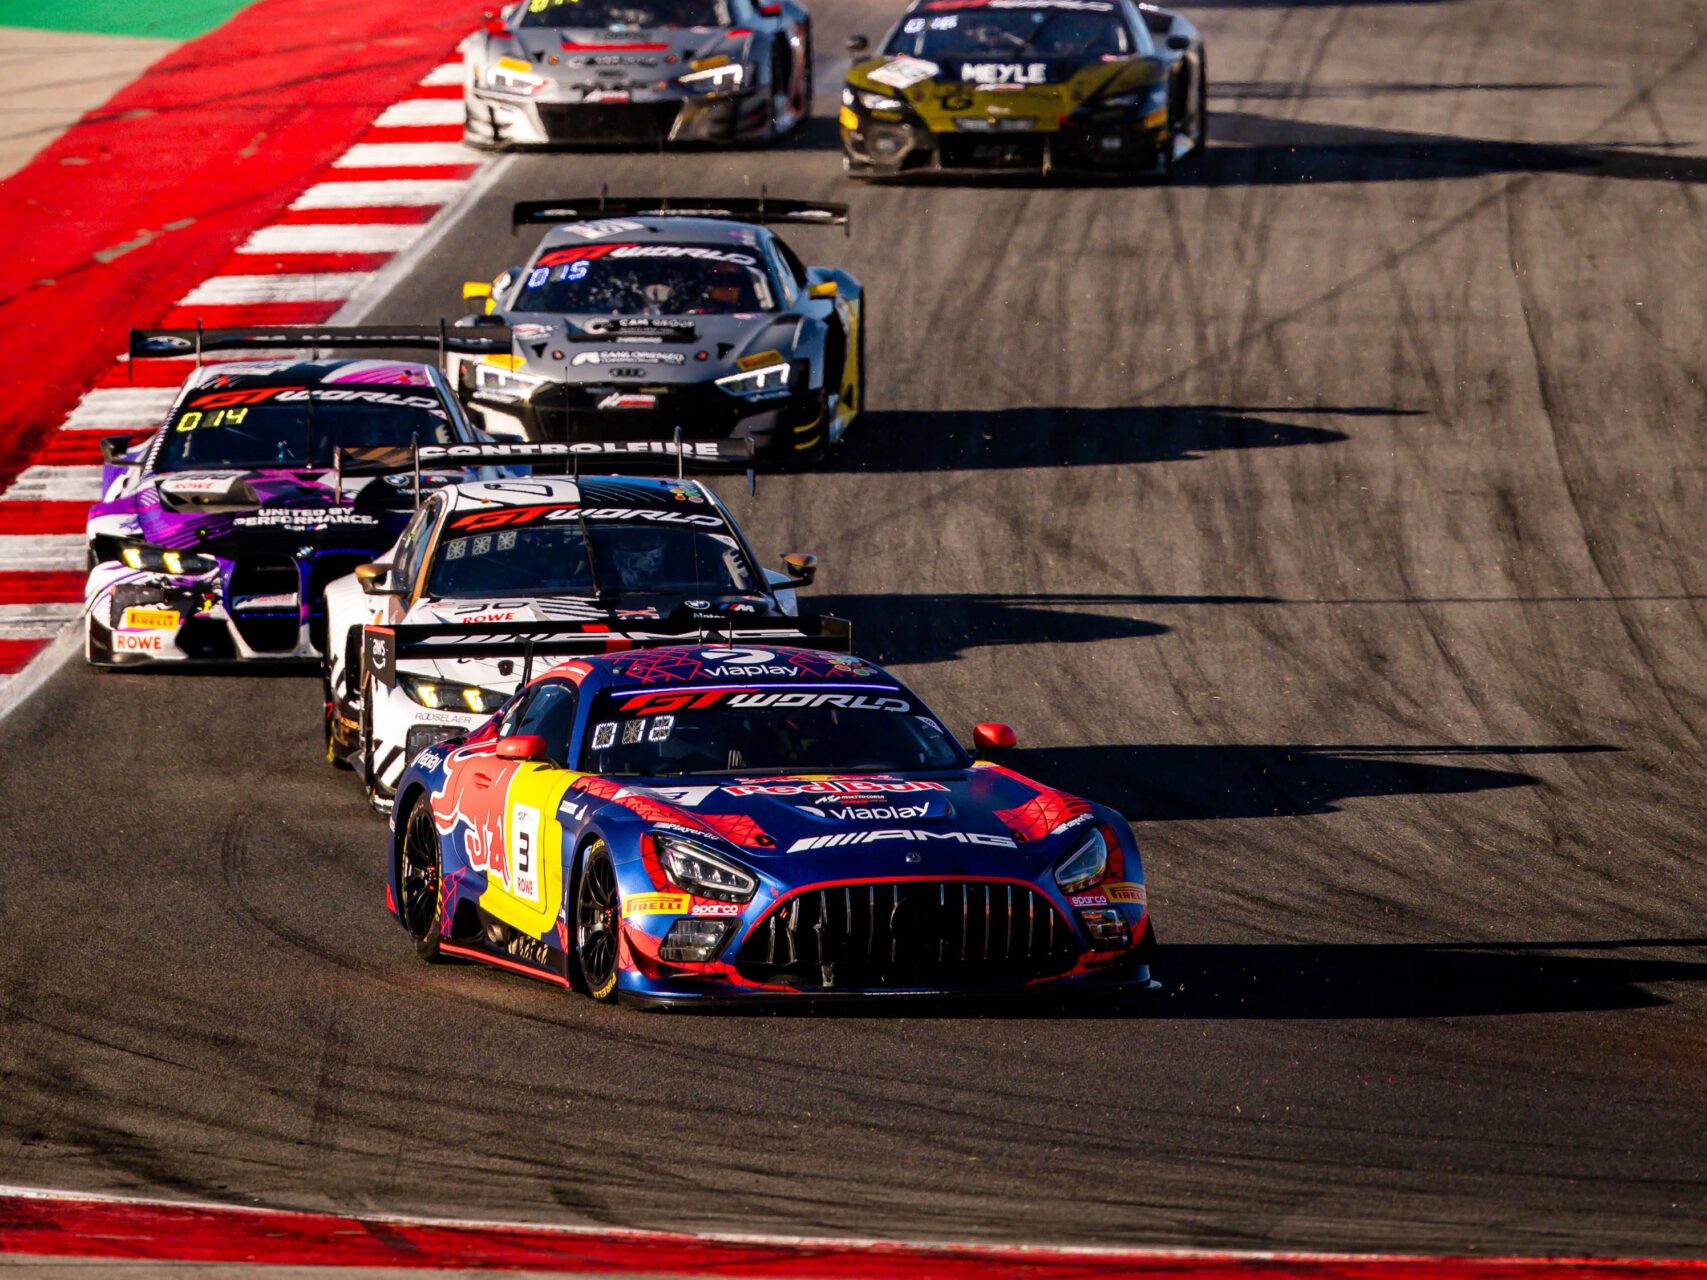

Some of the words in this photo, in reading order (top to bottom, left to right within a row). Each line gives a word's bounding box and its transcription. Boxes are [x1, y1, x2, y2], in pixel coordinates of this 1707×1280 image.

[610, 246, 757, 266] WORLD
[274, 390, 440, 409] WORLD
[418, 442, 719, 457] CONTROLFIRE
[258, 507, 326, 517] UNITED
[327, 506, 355, 516] BY
[449, 504, 580, 531] GT
[544, 507, 724, 526] WORLD
[130, 612, 173, 627] PIRELLI
[462, 612, 515, 624] ROWE
[117, 635, 162, 650] ROWE
[372, 638, 386, 656] aws
[703, 661, 799, 679] viaplay
[619, 688, 762, 716] GT
[726, 693, 911, 713] WORLD
[721, 782, 838, 797] Red
[837, 781, 952, 793] Bull
[829, 801, 930, 821] viaplay
[519, 831, 530, 873] 3
[517, 877, 533, 896] ROWE
[626, 896, 684, 913] PIRELLI
[1072, 895, 1107, 905] sparco
[691, 904, 738, 914] sparco
